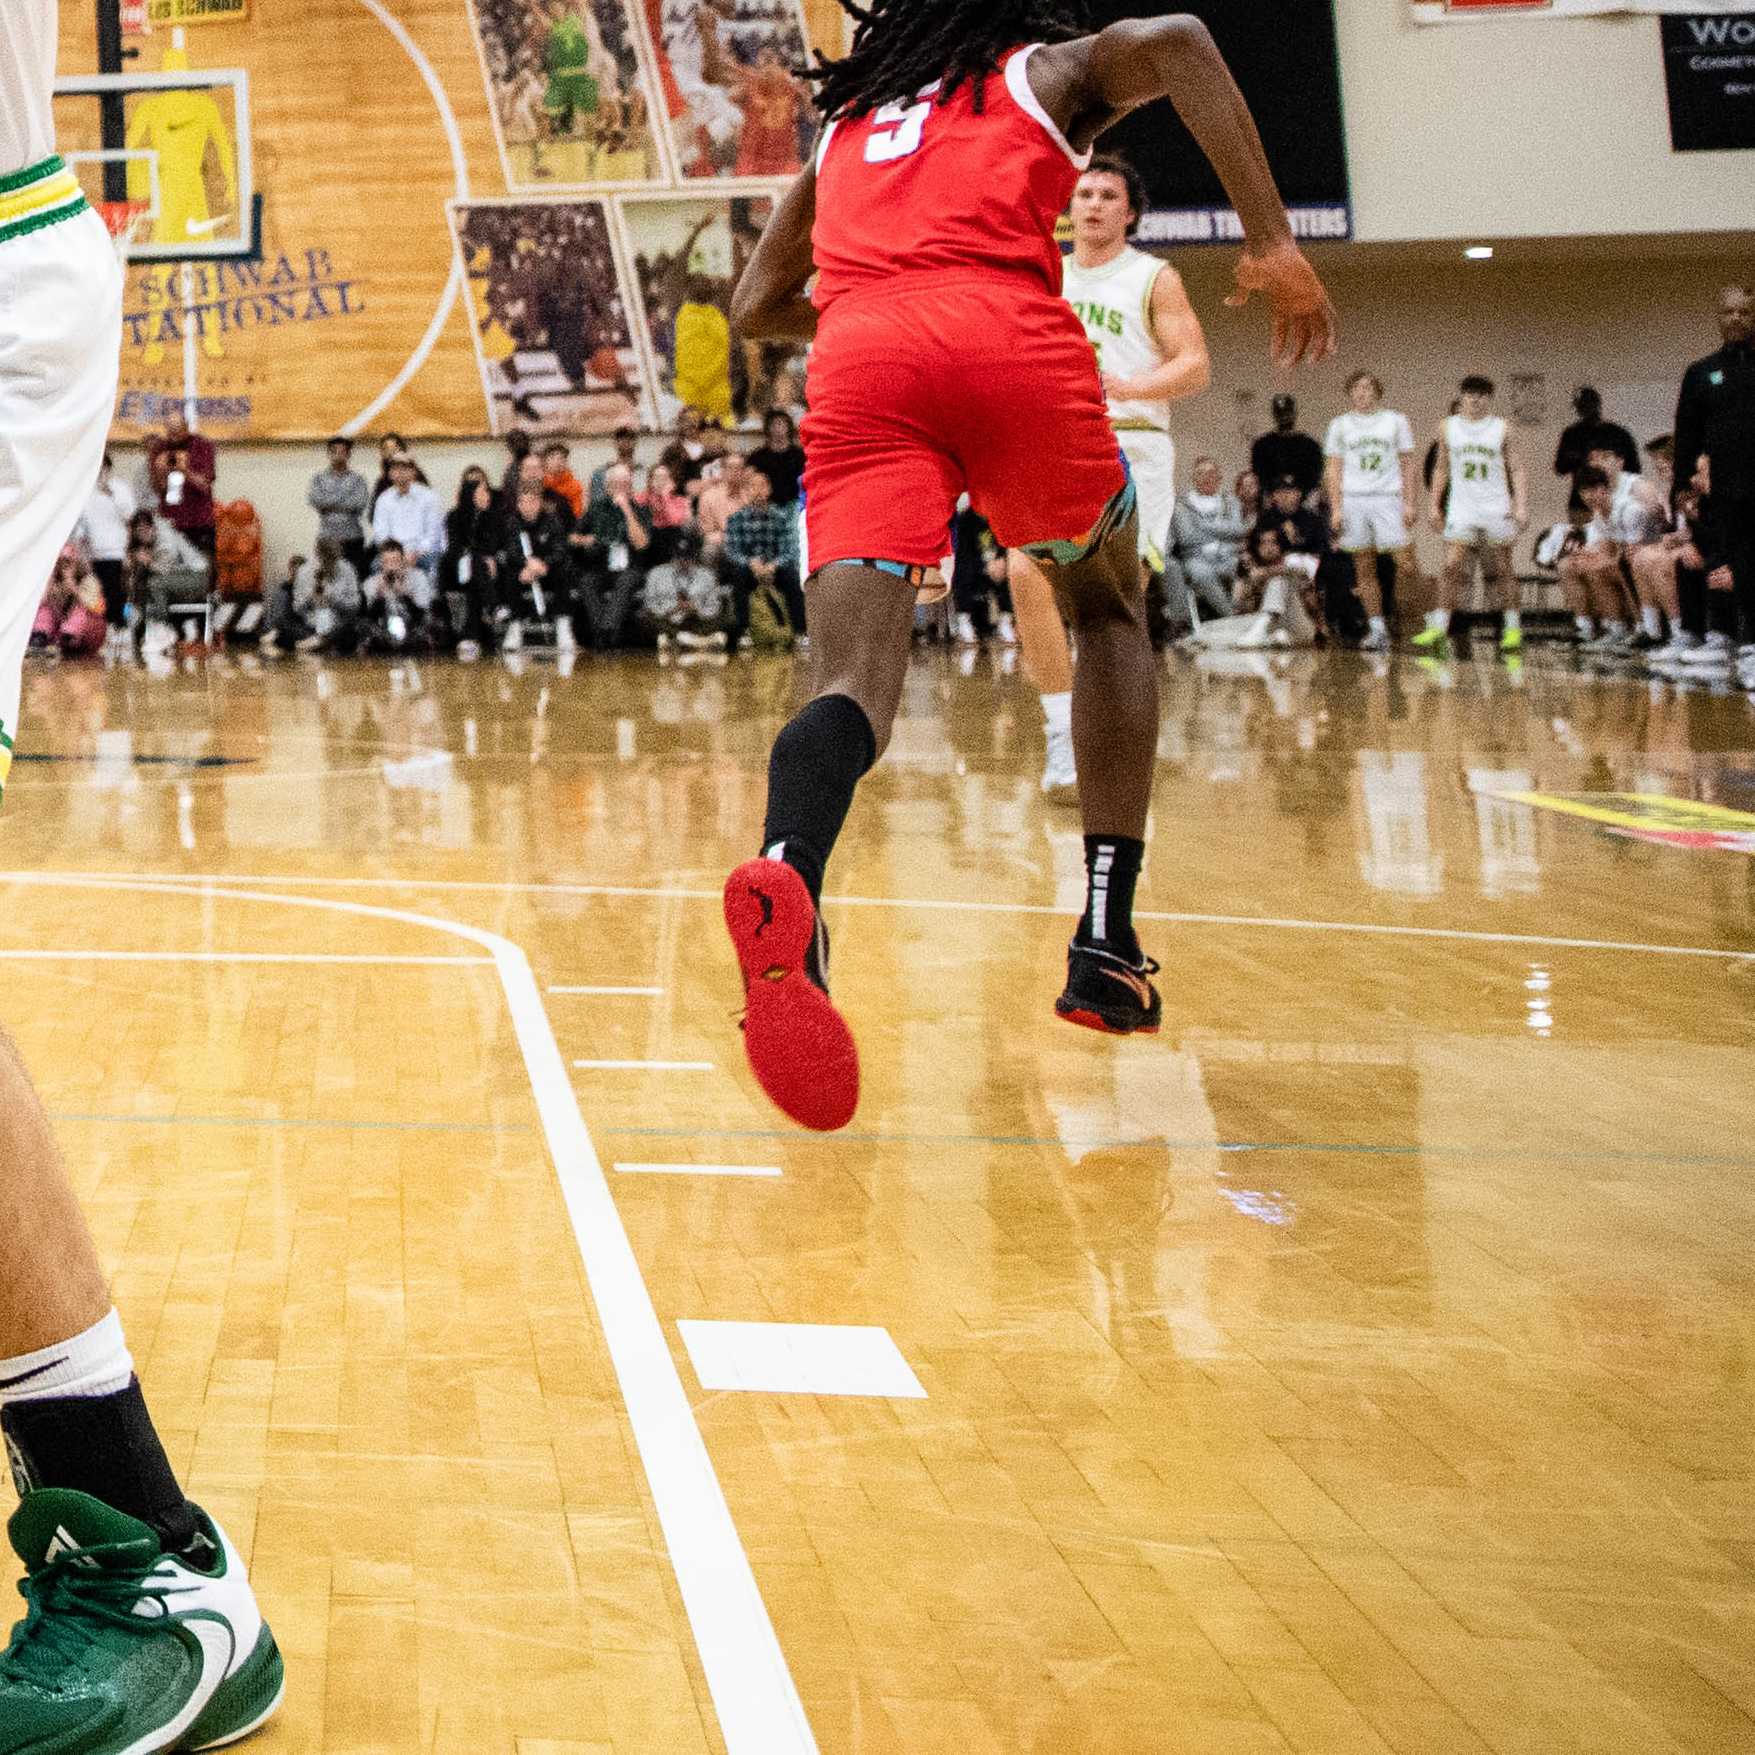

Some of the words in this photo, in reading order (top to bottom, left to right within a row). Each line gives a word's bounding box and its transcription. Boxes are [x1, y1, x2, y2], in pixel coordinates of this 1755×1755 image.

[1686, 18, 1755, 46] WO
[122, 281, 367, 347] TATIONAL
[1359, 452, 1382, 472] 12
[1463, 461, 1489, 480] 21
